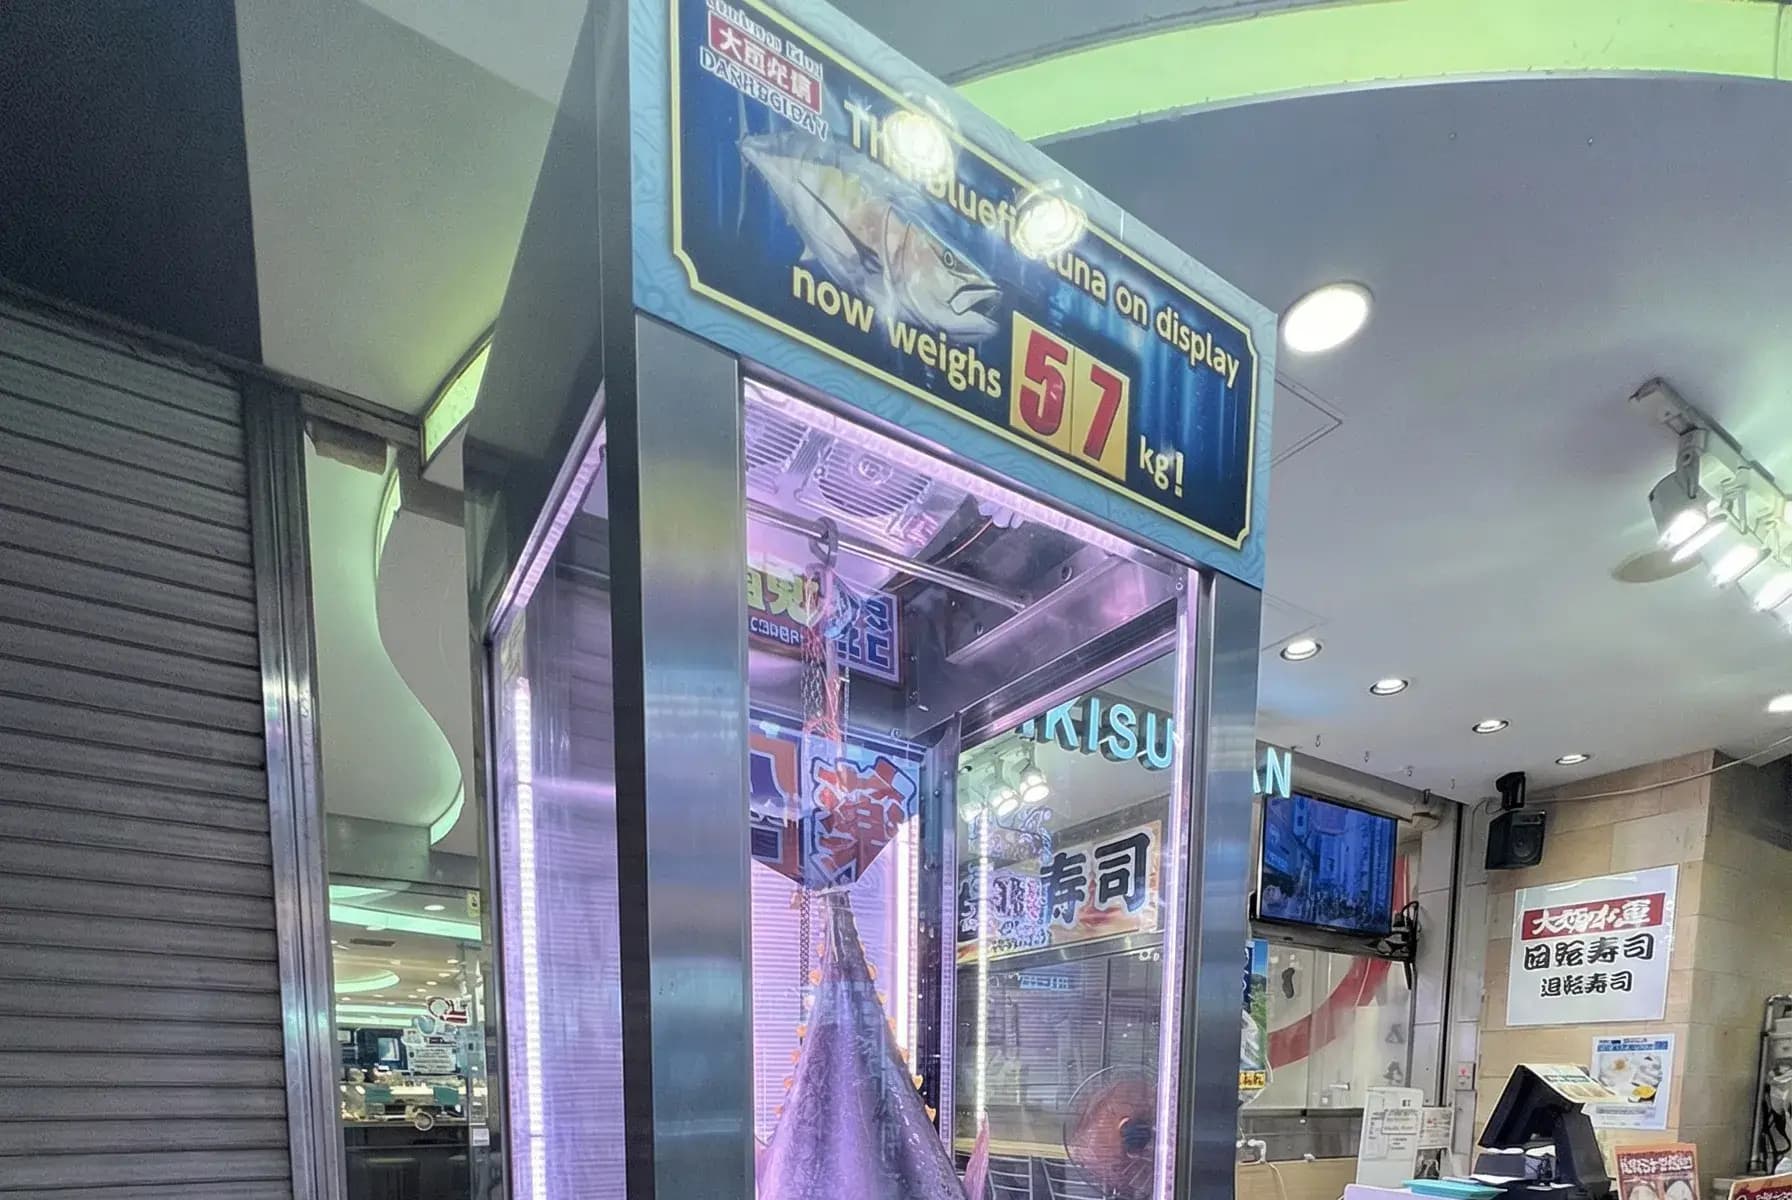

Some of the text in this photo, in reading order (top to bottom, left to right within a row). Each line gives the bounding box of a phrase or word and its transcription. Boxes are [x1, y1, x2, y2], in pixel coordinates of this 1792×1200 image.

[844, 100, 914, 181] Th
[926, 165, 1026, 246] bluefi
[1116, 285, 1148, 326] on
[1156, 306, 1240, 389] display
[792, 266, 1184, 498] now weighs 57 kg!
